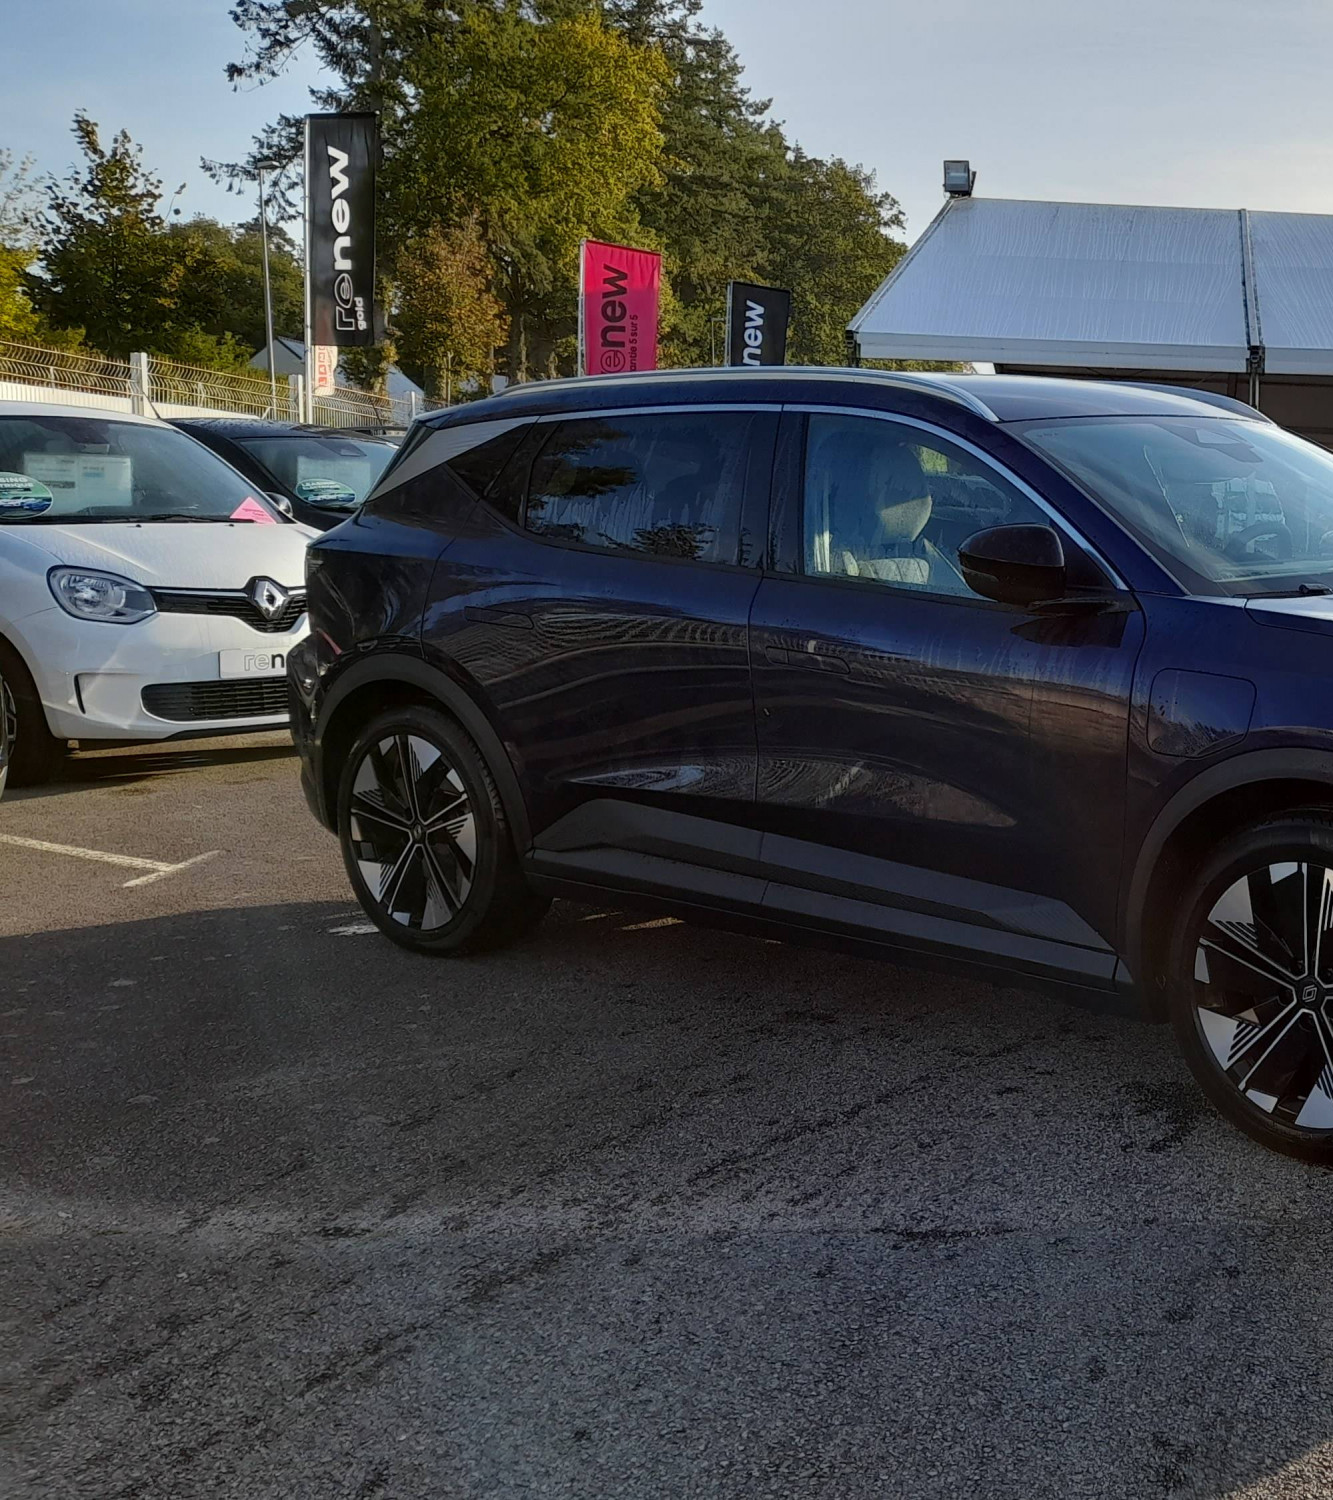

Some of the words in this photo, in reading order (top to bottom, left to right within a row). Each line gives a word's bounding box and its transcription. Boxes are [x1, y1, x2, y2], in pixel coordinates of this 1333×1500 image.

[327, 145, 356, 331] renew
[354, 296, 367, 331] gold
[600, 263, 629, 374] enew
[630, 321, 638, 338] sur
[742, 299, 765, 366] new
[629, 346, 638, 371] antie
[244, 653, 285, 671] ren
